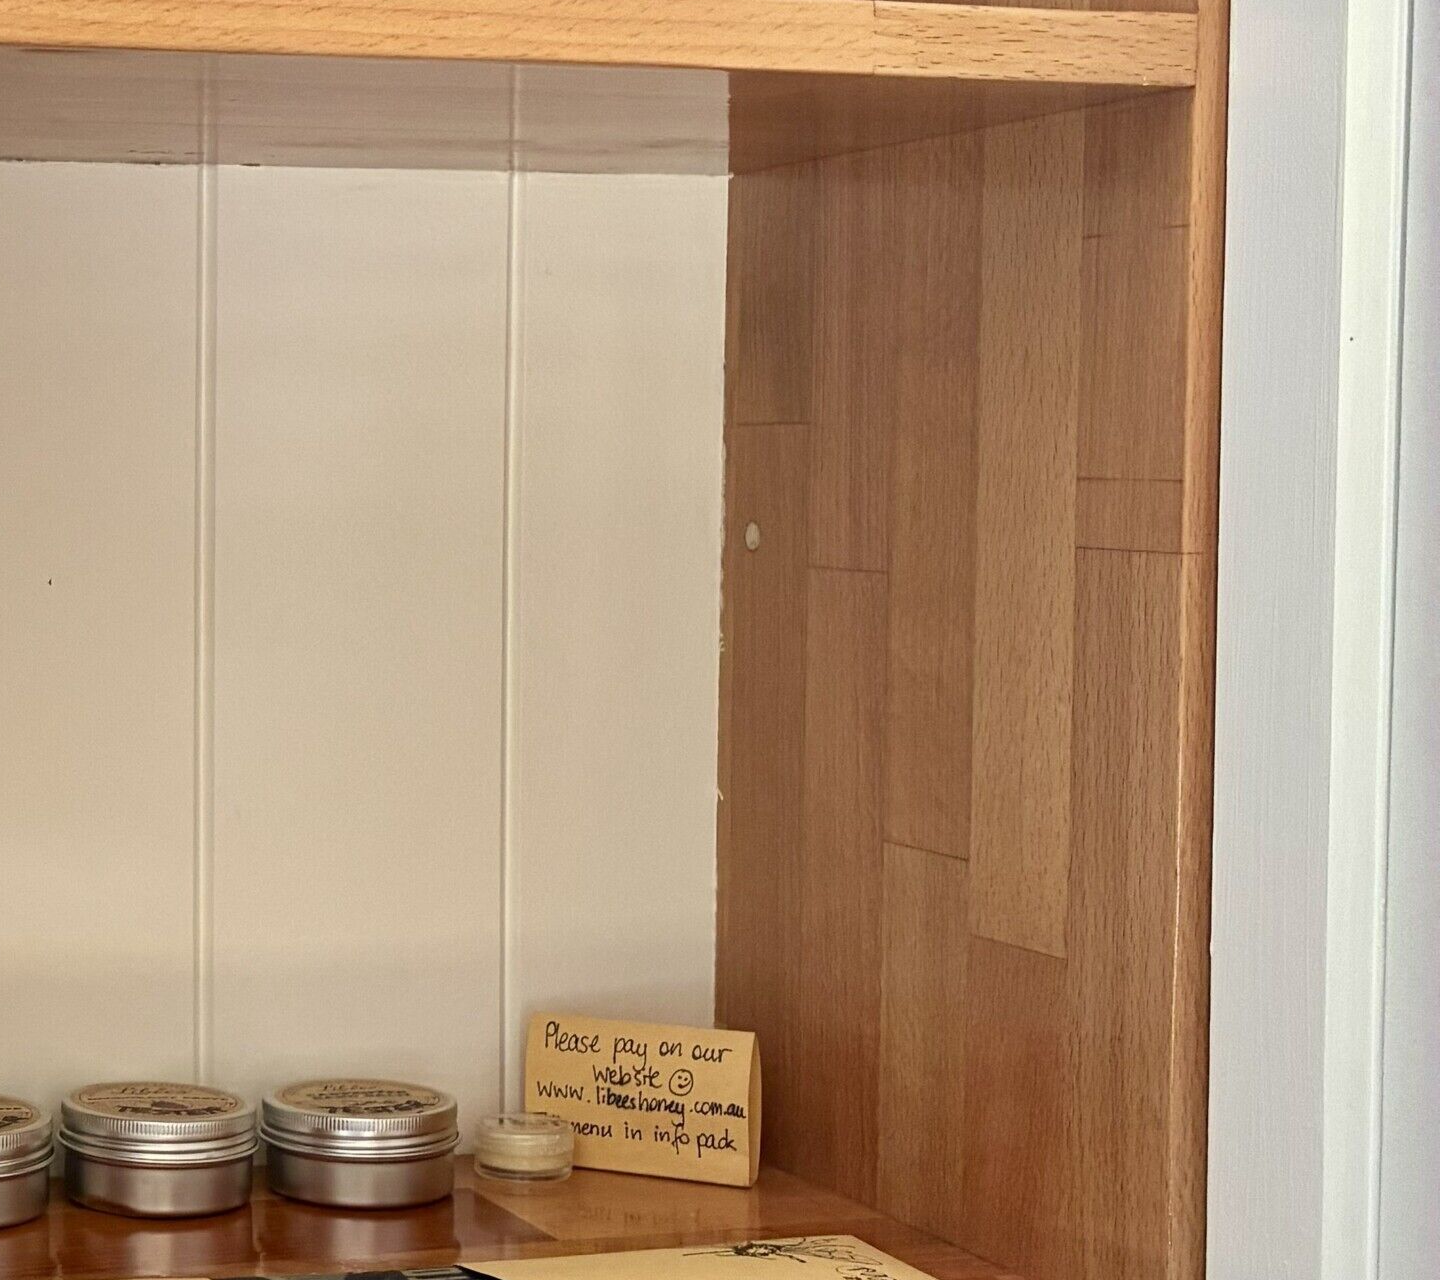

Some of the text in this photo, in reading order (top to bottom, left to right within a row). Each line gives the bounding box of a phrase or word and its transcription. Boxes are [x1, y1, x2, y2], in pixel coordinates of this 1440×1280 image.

[545, 1021, 733, 1071] Please pay on our
[624, 1122, 642, 1141] in
[654, 1123, 690, 1154] info
[697, 1130, 737, 1158] pack
